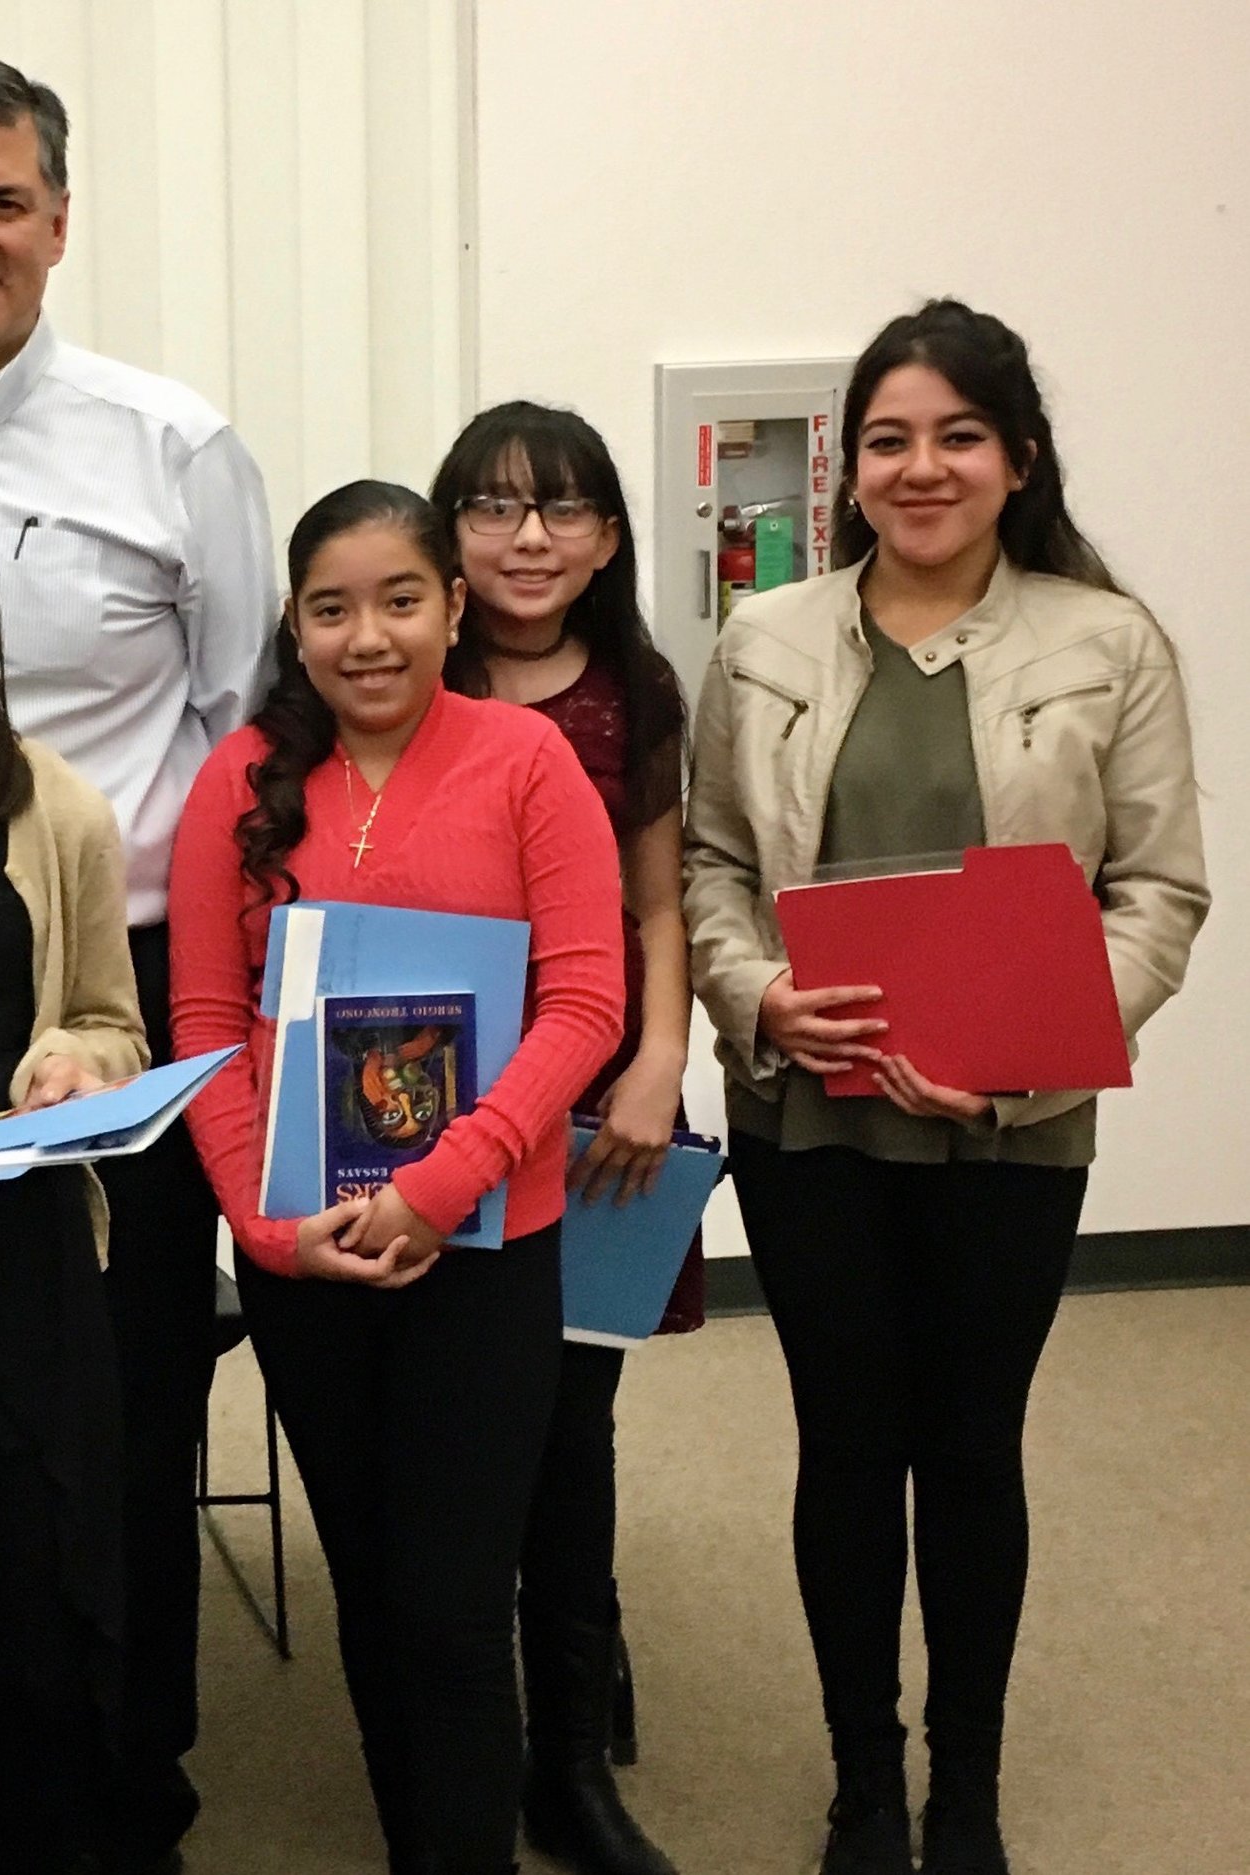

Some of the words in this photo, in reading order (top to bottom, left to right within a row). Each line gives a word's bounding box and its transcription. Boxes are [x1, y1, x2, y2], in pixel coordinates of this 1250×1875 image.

[812, 415, 829, 493] FIRE
[336, 1006, 408, 1019] TRONCOSO
[412, 1005, 462, 1017] SERGIO
[337, 1167, 388, 1179] ESSAYS
